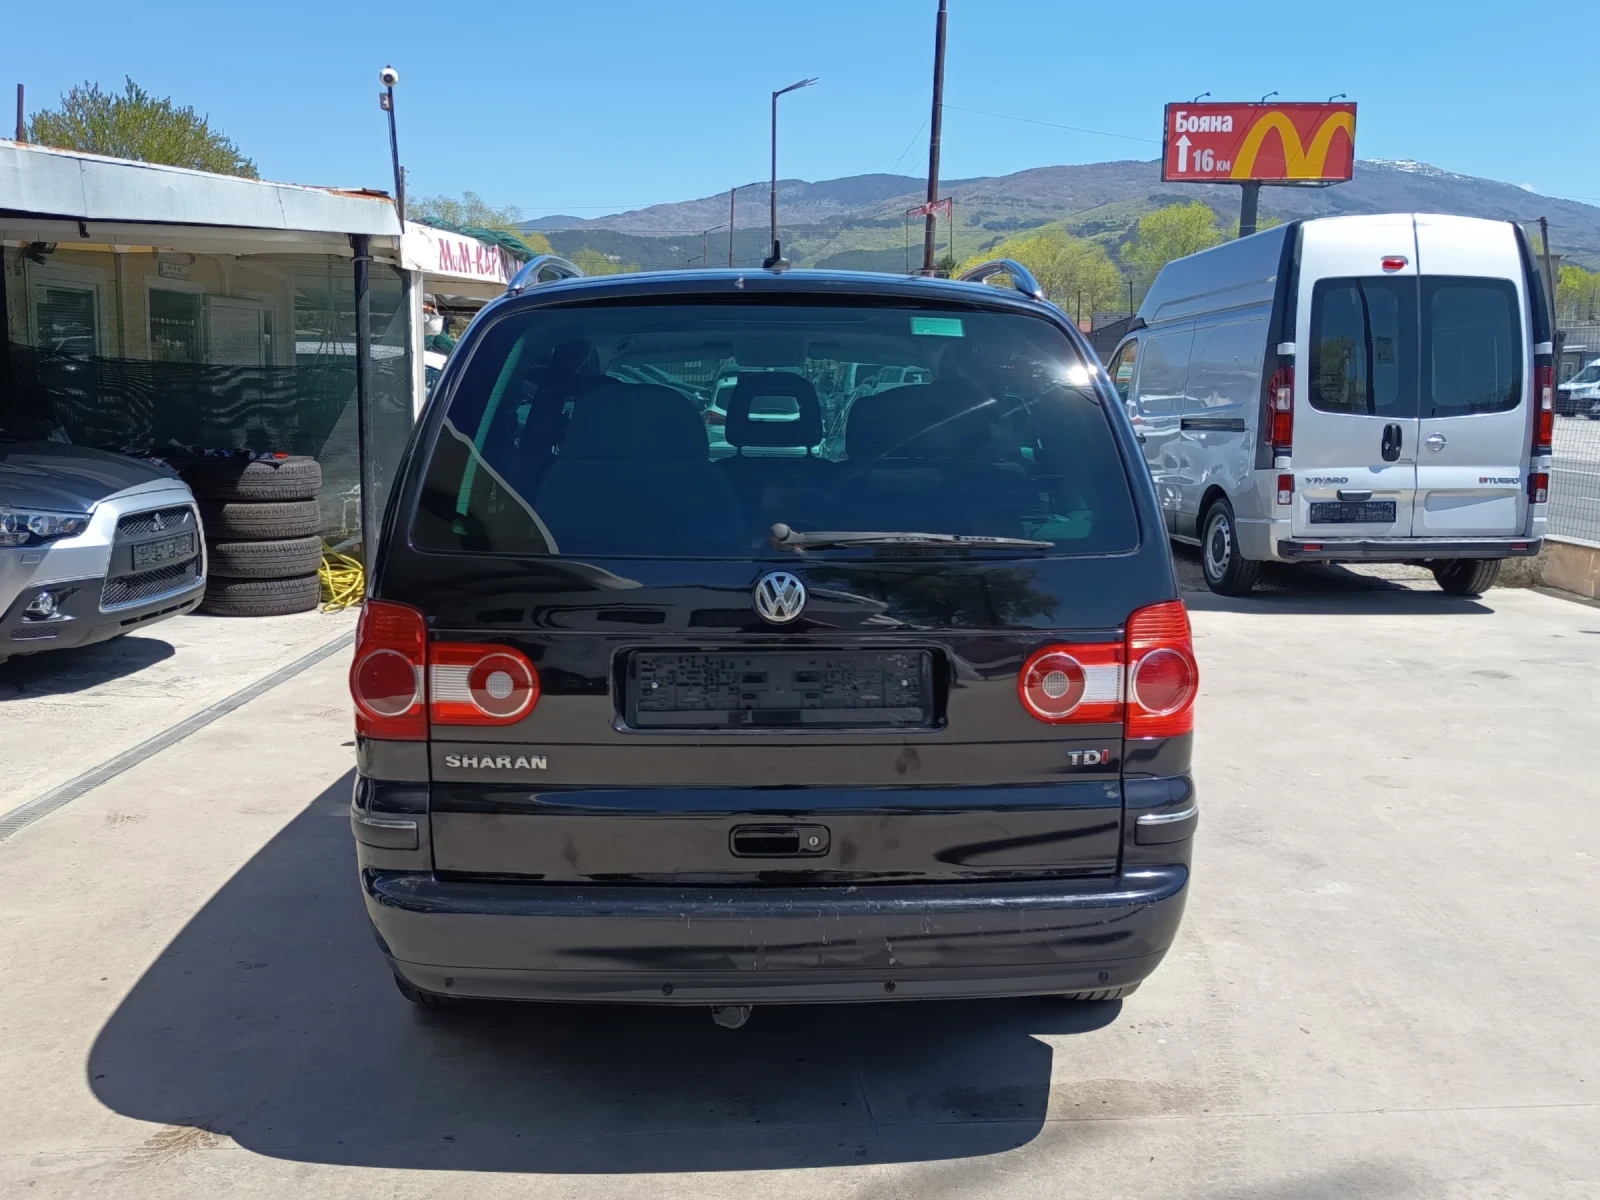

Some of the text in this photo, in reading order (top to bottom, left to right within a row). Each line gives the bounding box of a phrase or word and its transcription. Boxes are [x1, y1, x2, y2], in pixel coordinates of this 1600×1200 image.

[1175, 111, 1233, 133] Бояна
[1193, 149, 1214, 172] 16
[1305, 477, 1349, 485] VIVARO
[445, 754, 548, 769] SHARAN
